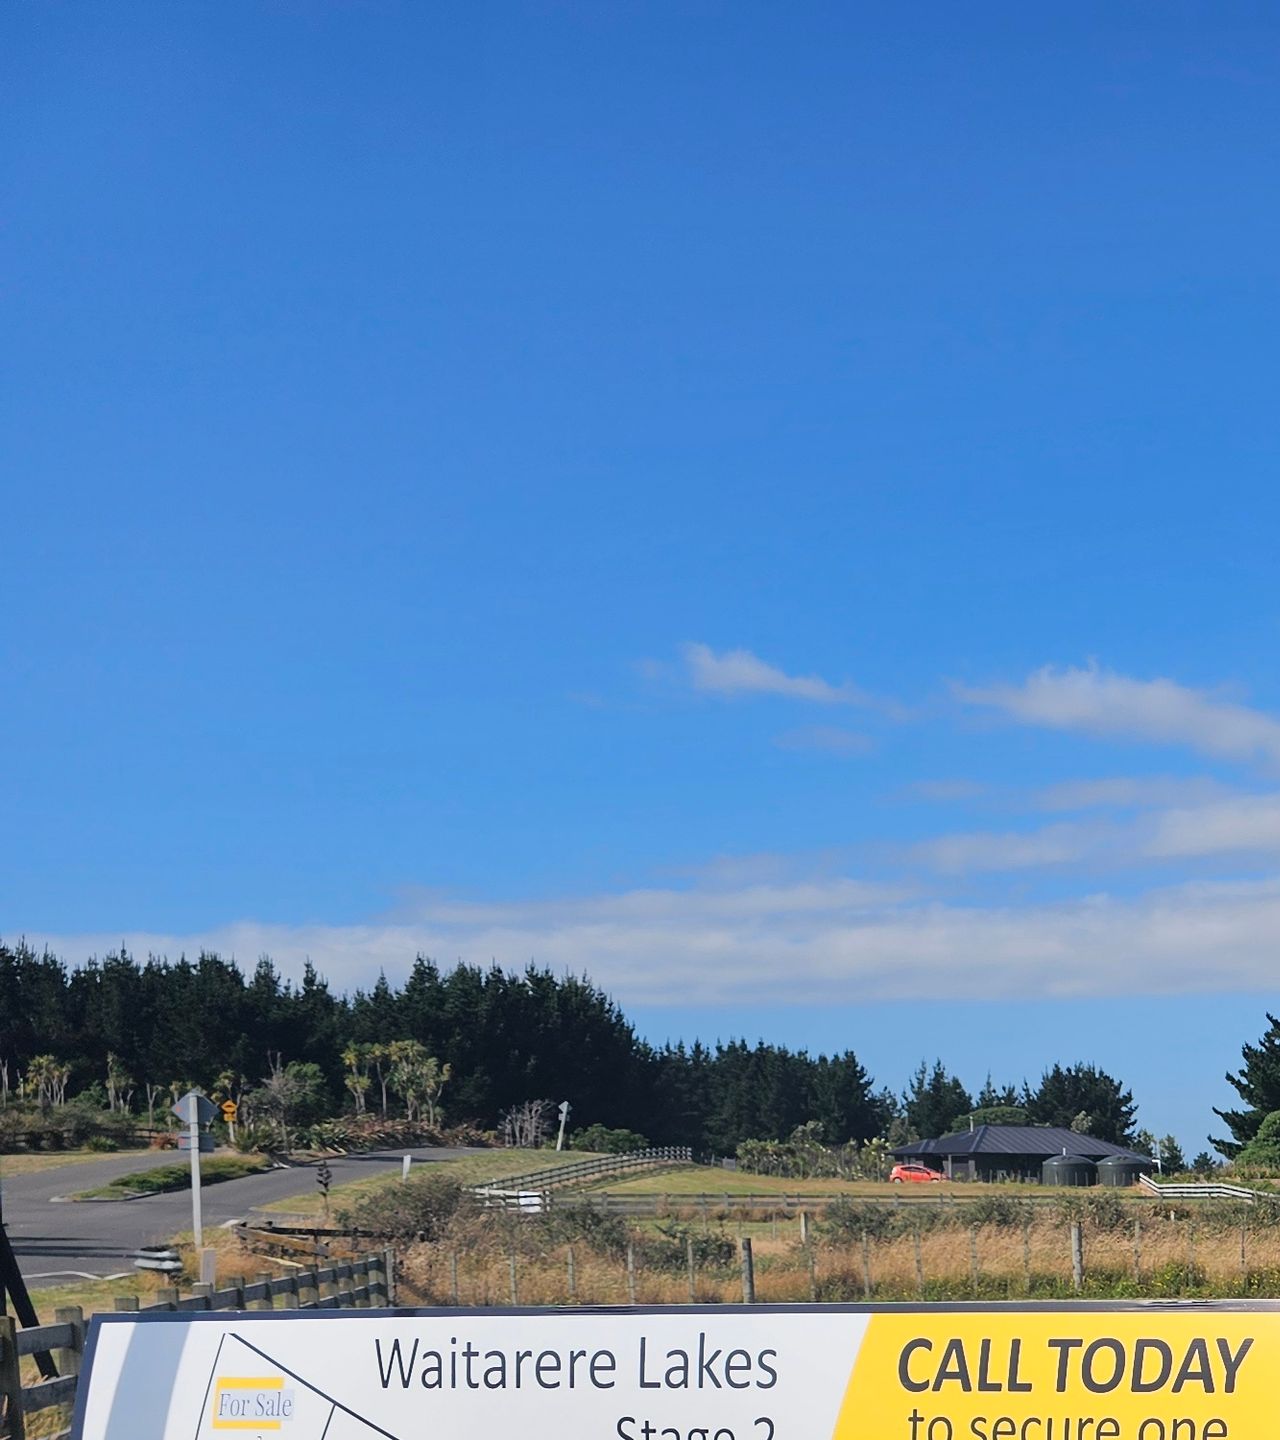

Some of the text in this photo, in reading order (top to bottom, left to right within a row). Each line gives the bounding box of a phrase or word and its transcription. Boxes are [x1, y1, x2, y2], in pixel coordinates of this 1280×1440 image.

[375, 1332, 778, 1389] Waitarere Lakes
[898, 1337, 1254, 1394] CALL TODAY
[218, 1392, 292, 1417] For Sale
